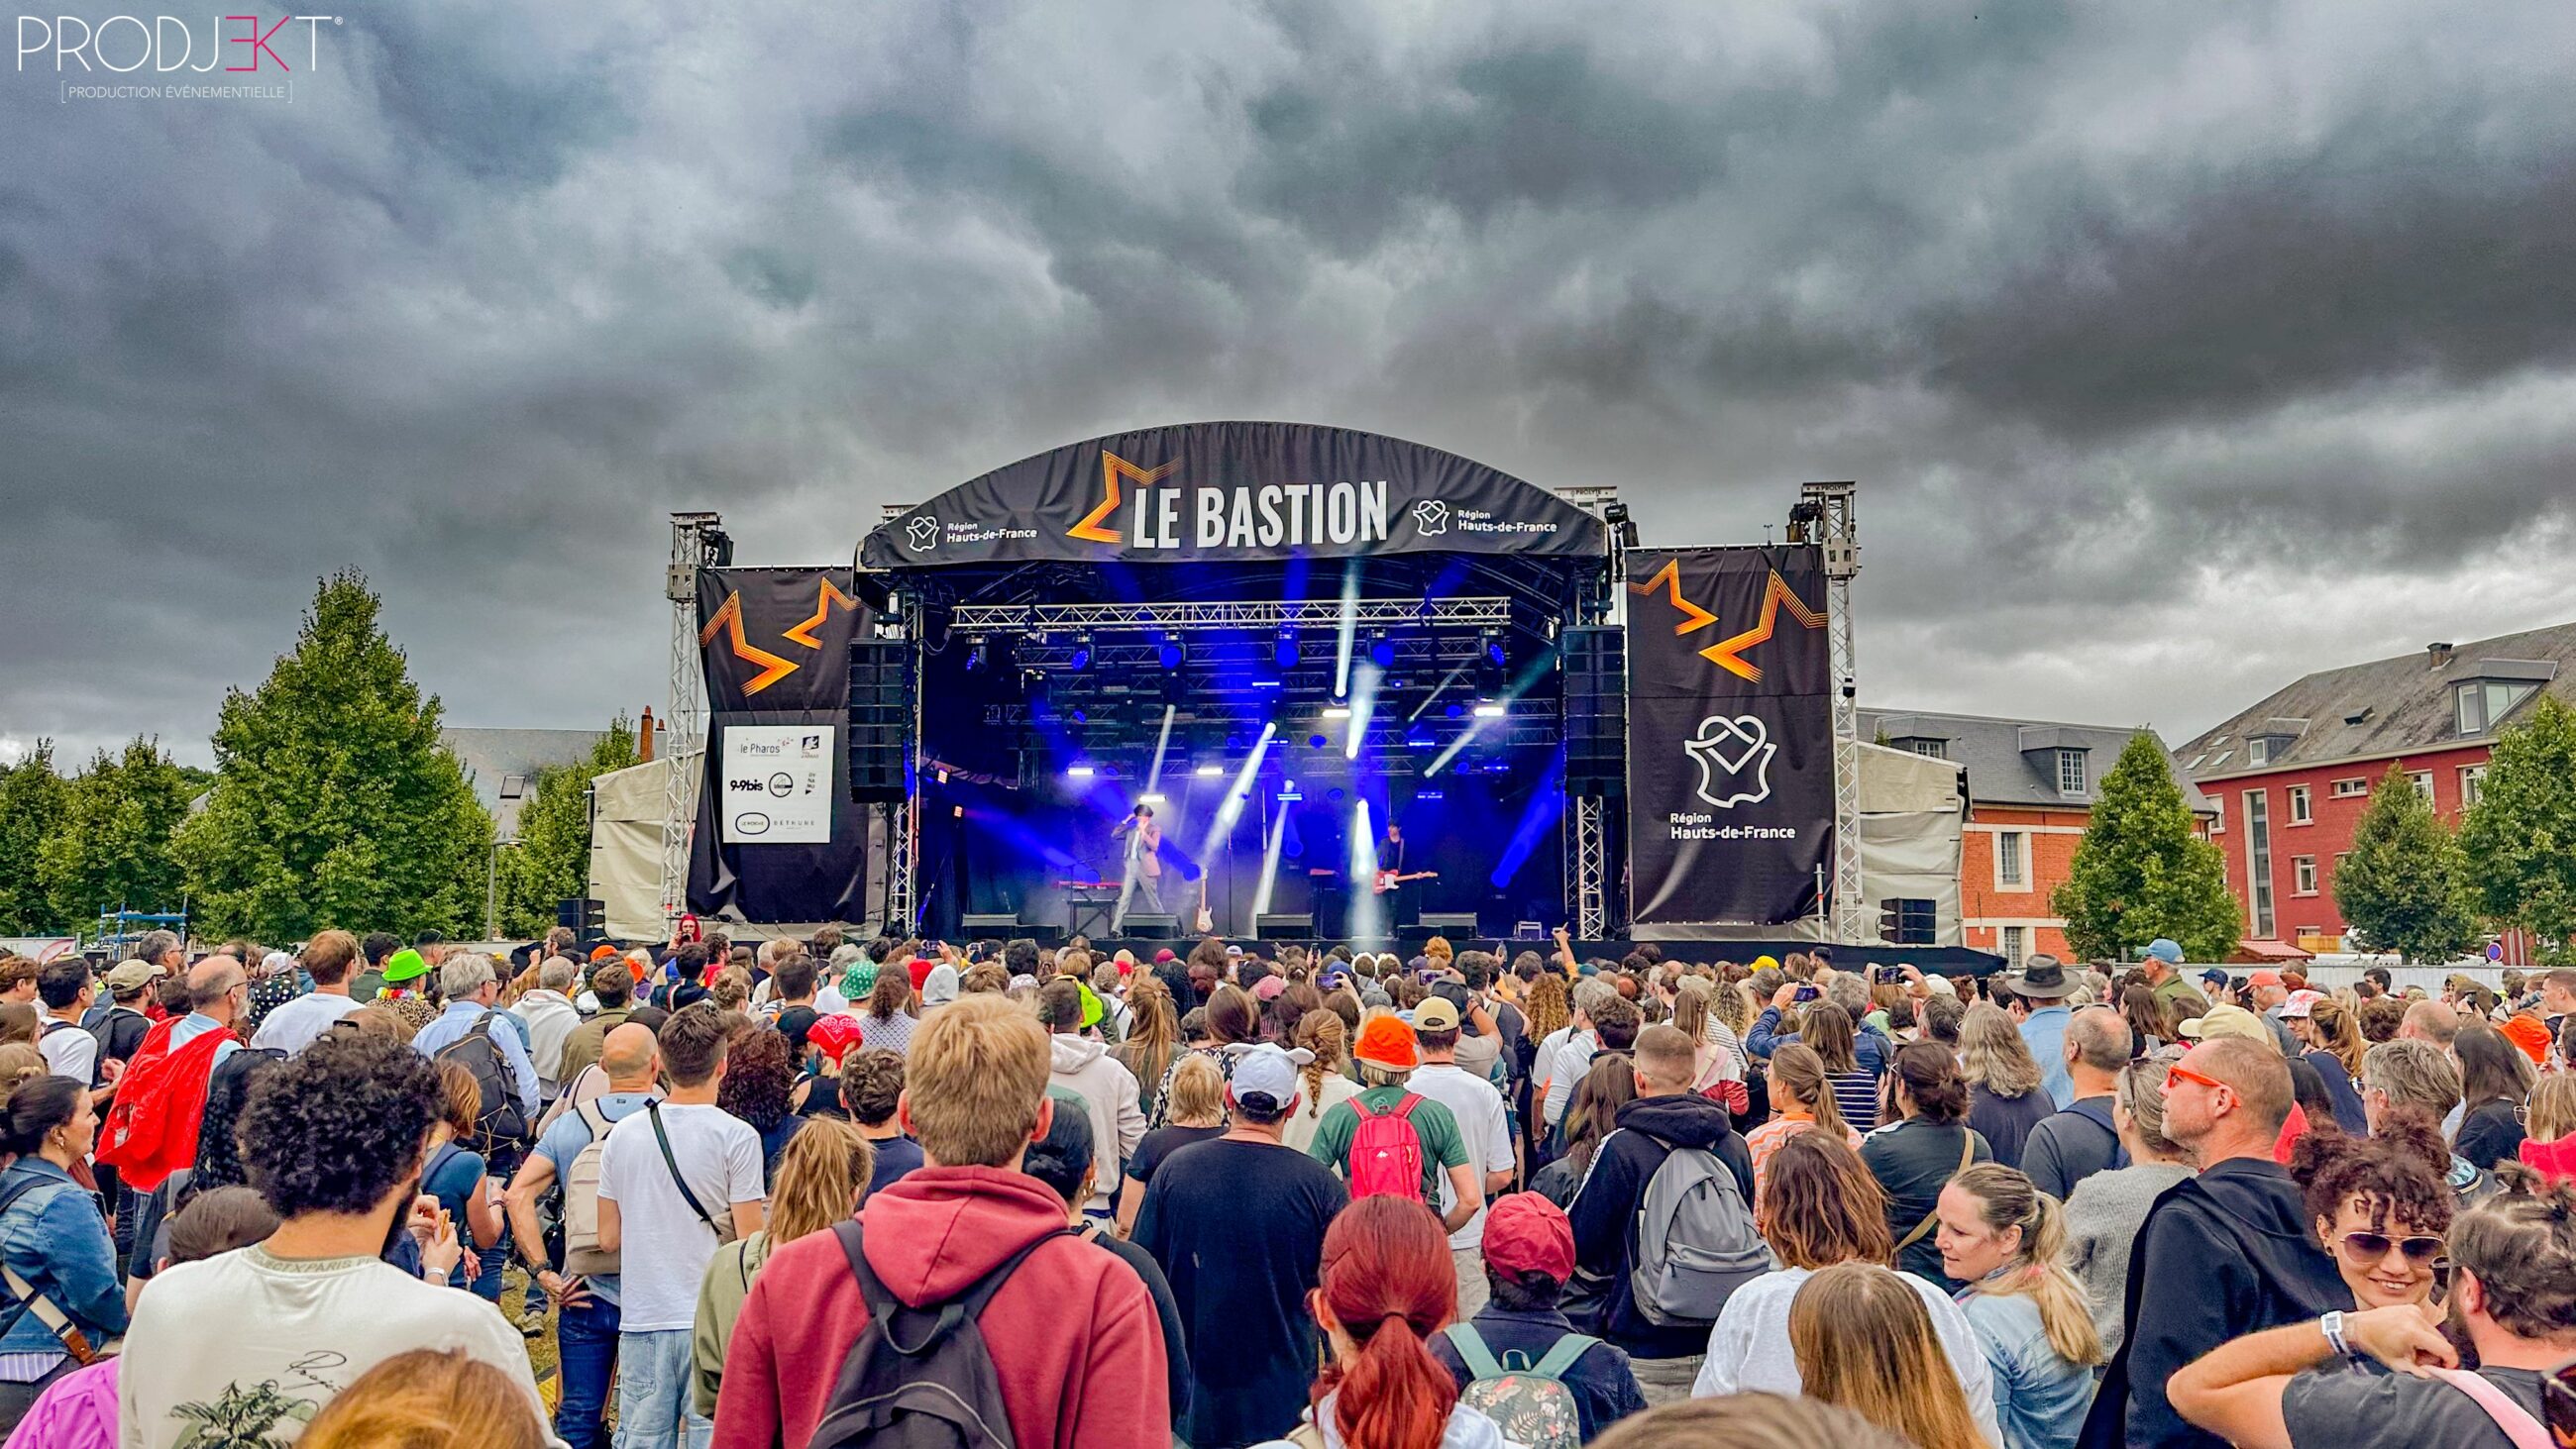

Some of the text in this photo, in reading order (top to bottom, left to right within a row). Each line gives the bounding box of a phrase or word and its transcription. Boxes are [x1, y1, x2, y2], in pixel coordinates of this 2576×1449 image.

[1133, 480, 1387, 549] LE BASTION
[1457, 509, 1491, 521] Région
[947, 522, 978, 532] Région
[1457, 520, 1557, 533] Hauts-de-France
[946, 528, 1038, 543] Hauts-de-France
[740, 743, 781, 754] le Pharos
[730, 778, 764, 791] 9-9bis
[1669, 813, 1712, 826] Région
[1670, 825, 1796, 840] Hauts-de-France
